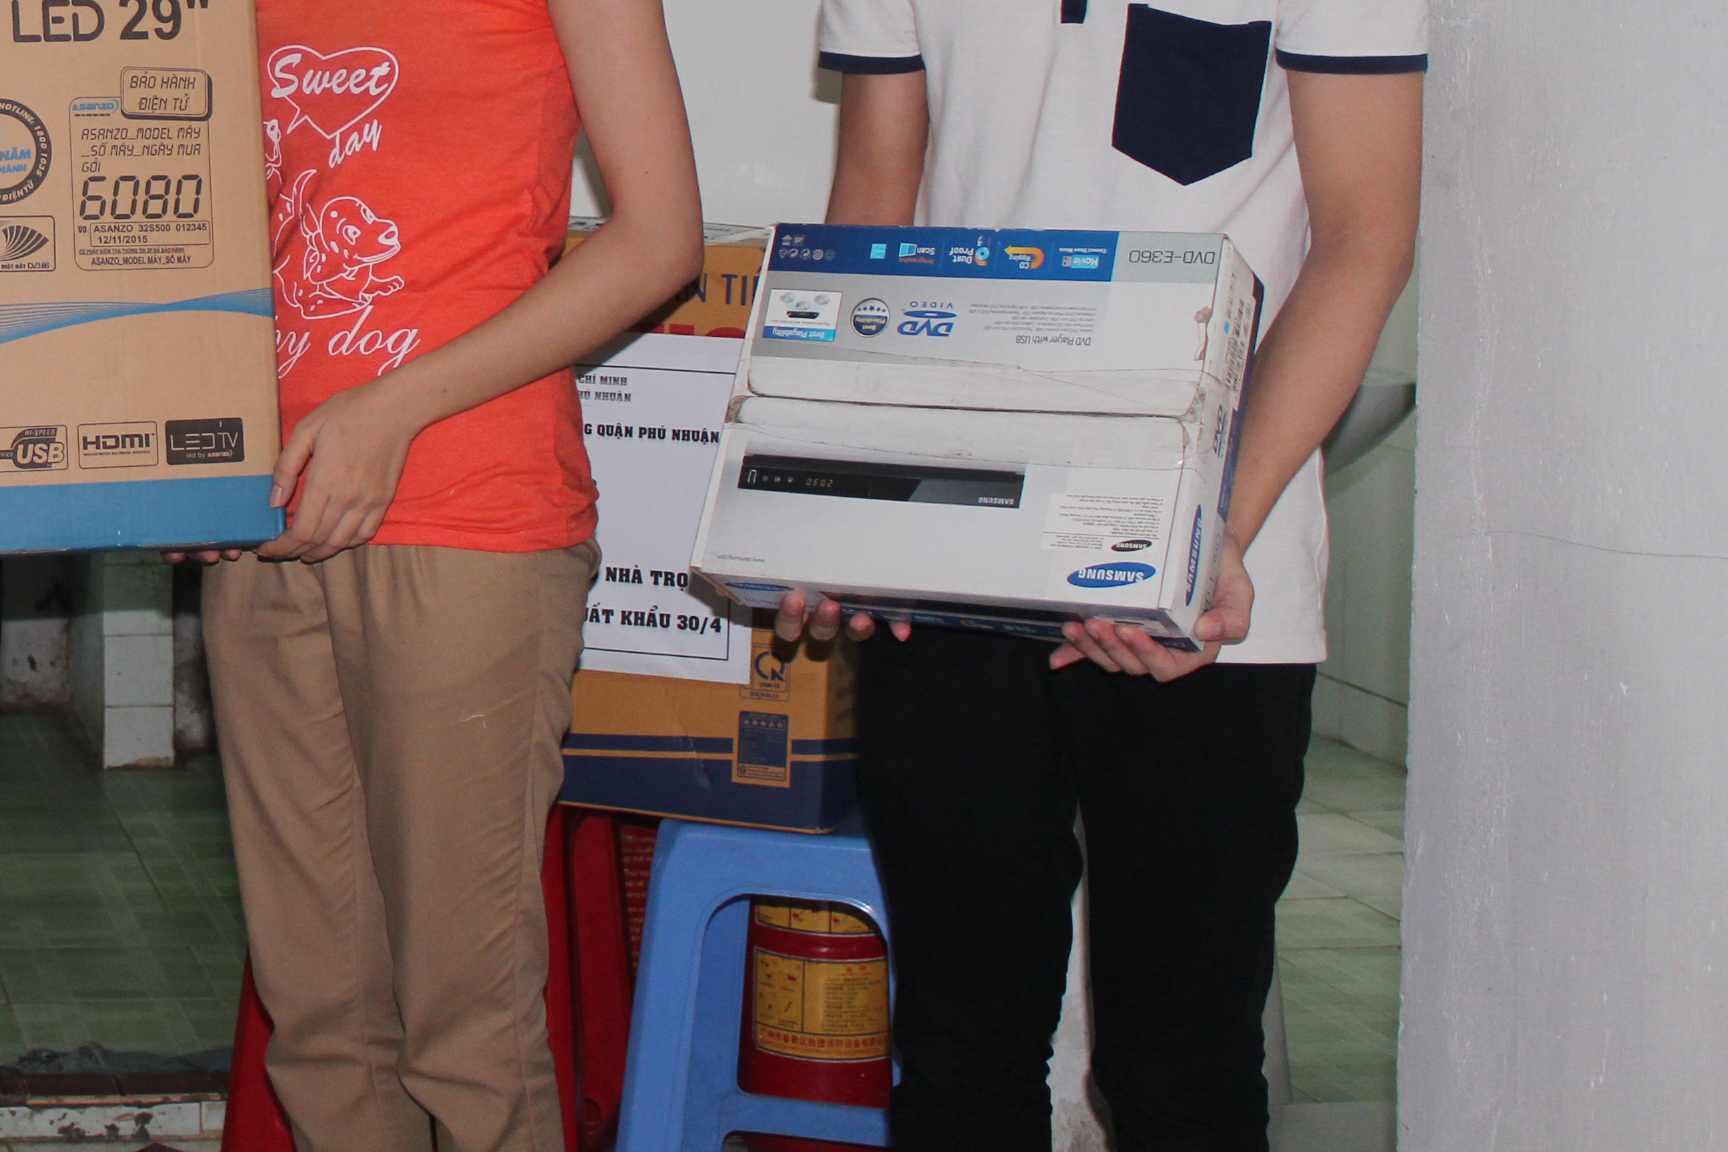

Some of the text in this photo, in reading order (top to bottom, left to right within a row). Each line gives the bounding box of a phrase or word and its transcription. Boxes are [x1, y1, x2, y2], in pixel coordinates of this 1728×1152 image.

[12, 0, 105, 43] LED
[130, 70, 196, 89] BẢO HÀNH
[271, 53, 393, 98] Sweet
[138, 93, 190, 113] ĐIỆN TỬ
[34, 125, 48, 149] 1800
[81, 125, 201, 140] ASANZO_MODEL MÁY
[110, 142, 173, 157] MÁY_NGÀY
[177, 143, 201, 156] MUA
[328, 119, 382, 168] day
[0, 147, 31, 161] NĂM
[36, 153, 48, 177] 1035
[2, 189, 24, 201] ĐIỆN
[79, 174, 202, 220] 6080
[93, 225, 133, 233] ASANZO
[175, 223, 207, 232] 012345
[98, 235, 148, 244] 12/11/2015
[916, 247, 936, 255] Scan
[949, 246, 974, 256] Proof
[1009, 253, 1031, 262] Ripping
[1129, 250, 1216, 265] DVD-E360
[92, 256, 145, 266] ASANZO_MODEL
[952, 255, 973, 264] Dust
[1019, 261, 1030, 269] CD
[1073, 257, 1099, 268] Movie
[910, 300, 953, 309] VIDEO
[772, 328, 810, 338] Playability
[897, 320, 955, 337] DVD
[328, 305, 421, 376] dog
[1015, 334, 1091, 346] DVD Player with USB
[600, 376, 627, 386] MINH
[24, 428, 56, 436] HI-SPEED
[597, 422, 633, 440] QUẬN
[638, 425, 666, 440] PHÚ
[672, 427, 720, 445] NHUẬN
[83, 433, 151, 450] HDMI
[170, 432, 239, 450] LED TV
[15, 441, 65, 464] USB
[198, 451, 206, 460] by
[978, 496, 1014, 505] SAMSUNG
[1116, 541, 1147, 549] SAMSUNG
[606, 564, 688, 591] NHÀ TRỌ
[1078, 569, 1145, 583] SAMSUNG
[621, 605, 671, 628] KHẨU
[677, 615, 721, 634] 30/4
